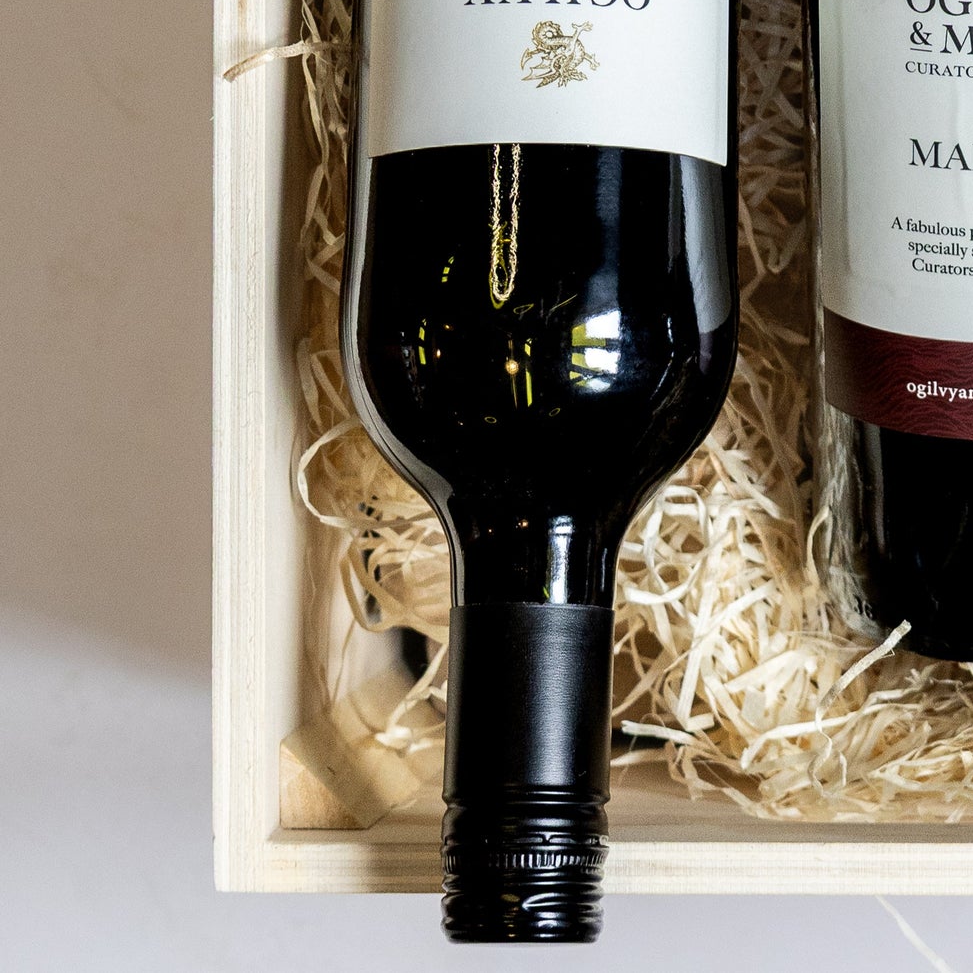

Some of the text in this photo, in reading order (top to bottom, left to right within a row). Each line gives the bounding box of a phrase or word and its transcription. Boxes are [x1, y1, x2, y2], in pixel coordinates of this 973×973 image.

[910, 21, 932, 46] &
[891, 217, 903, 230] A
[907, 219, 966, 237] fabulous
[908, 242, 968, 260] specially
